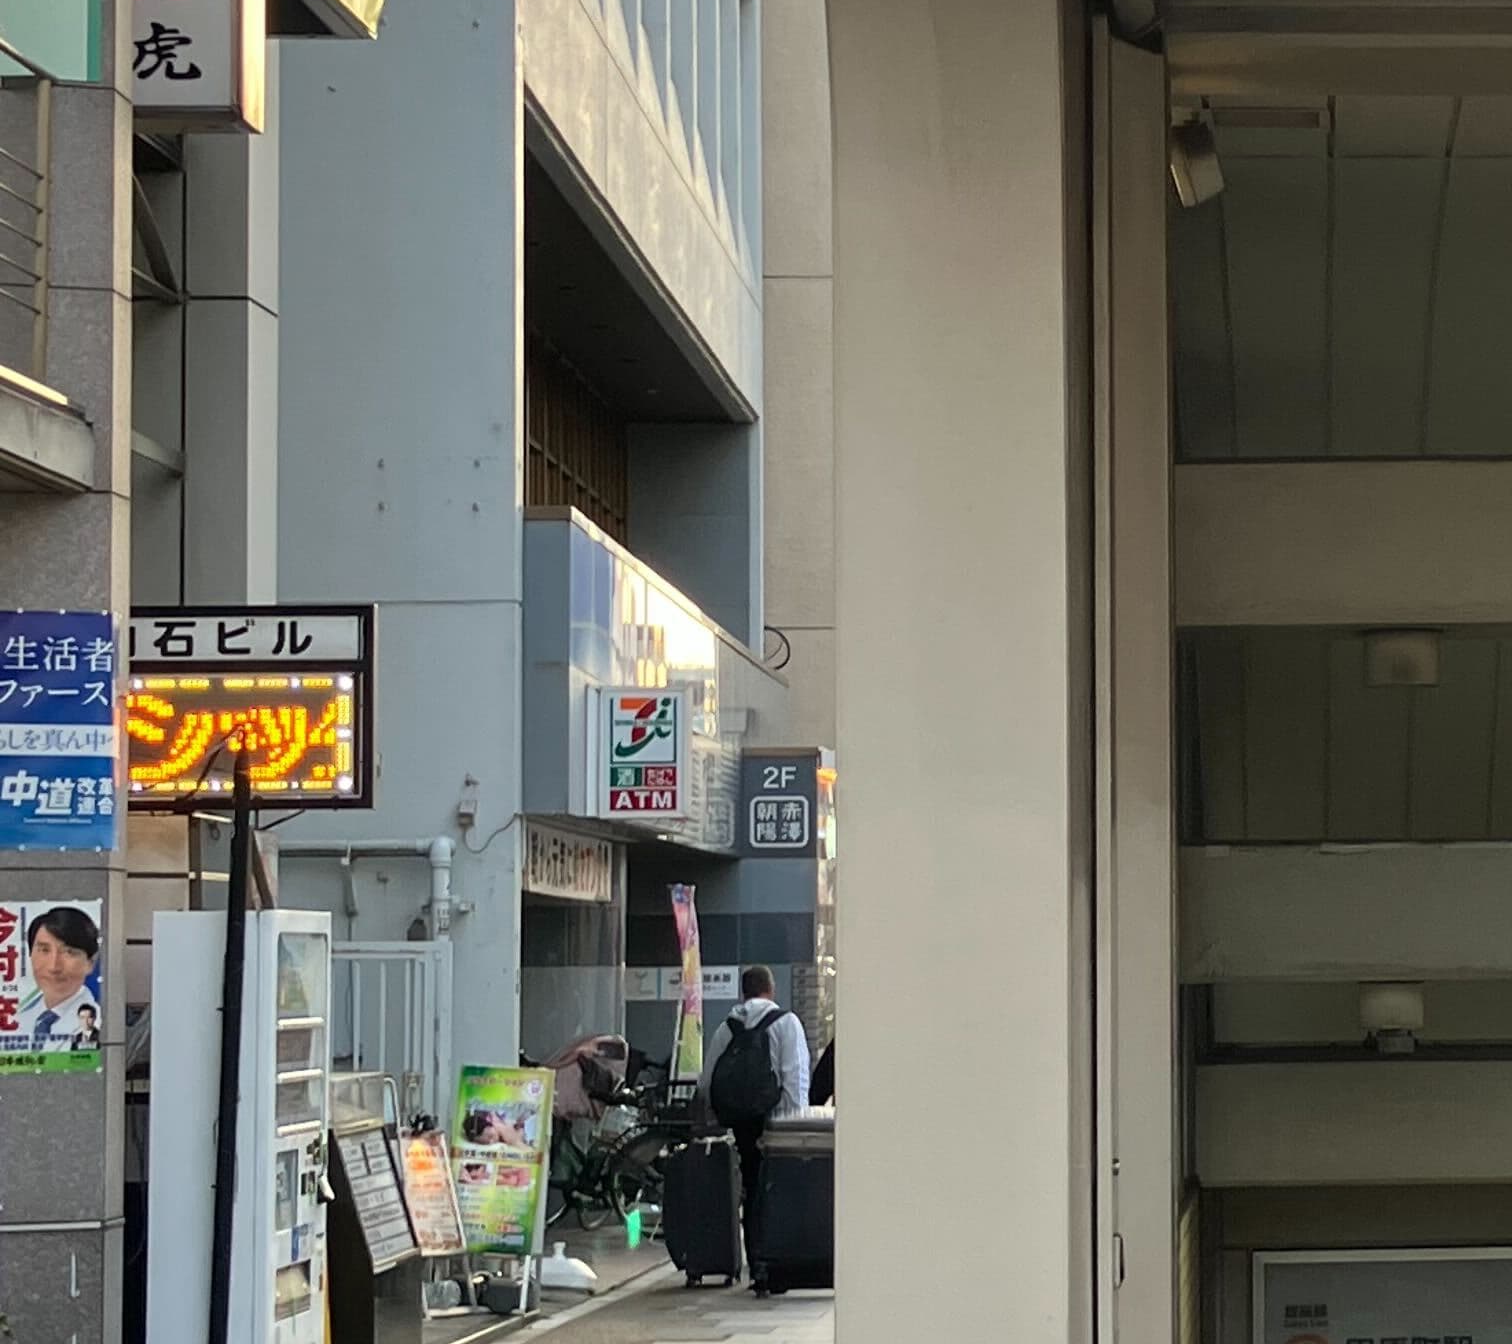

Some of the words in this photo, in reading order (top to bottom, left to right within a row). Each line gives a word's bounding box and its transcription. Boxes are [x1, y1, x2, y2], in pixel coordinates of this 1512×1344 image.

[129, 619, 313, 657] 石ビル
[3, 635, 114, 673] 生活者
[0, 728, 113, 752] しを真ん中
[763, 766, 797, 789] 2F
[615, 790, 673, 809] ATM
